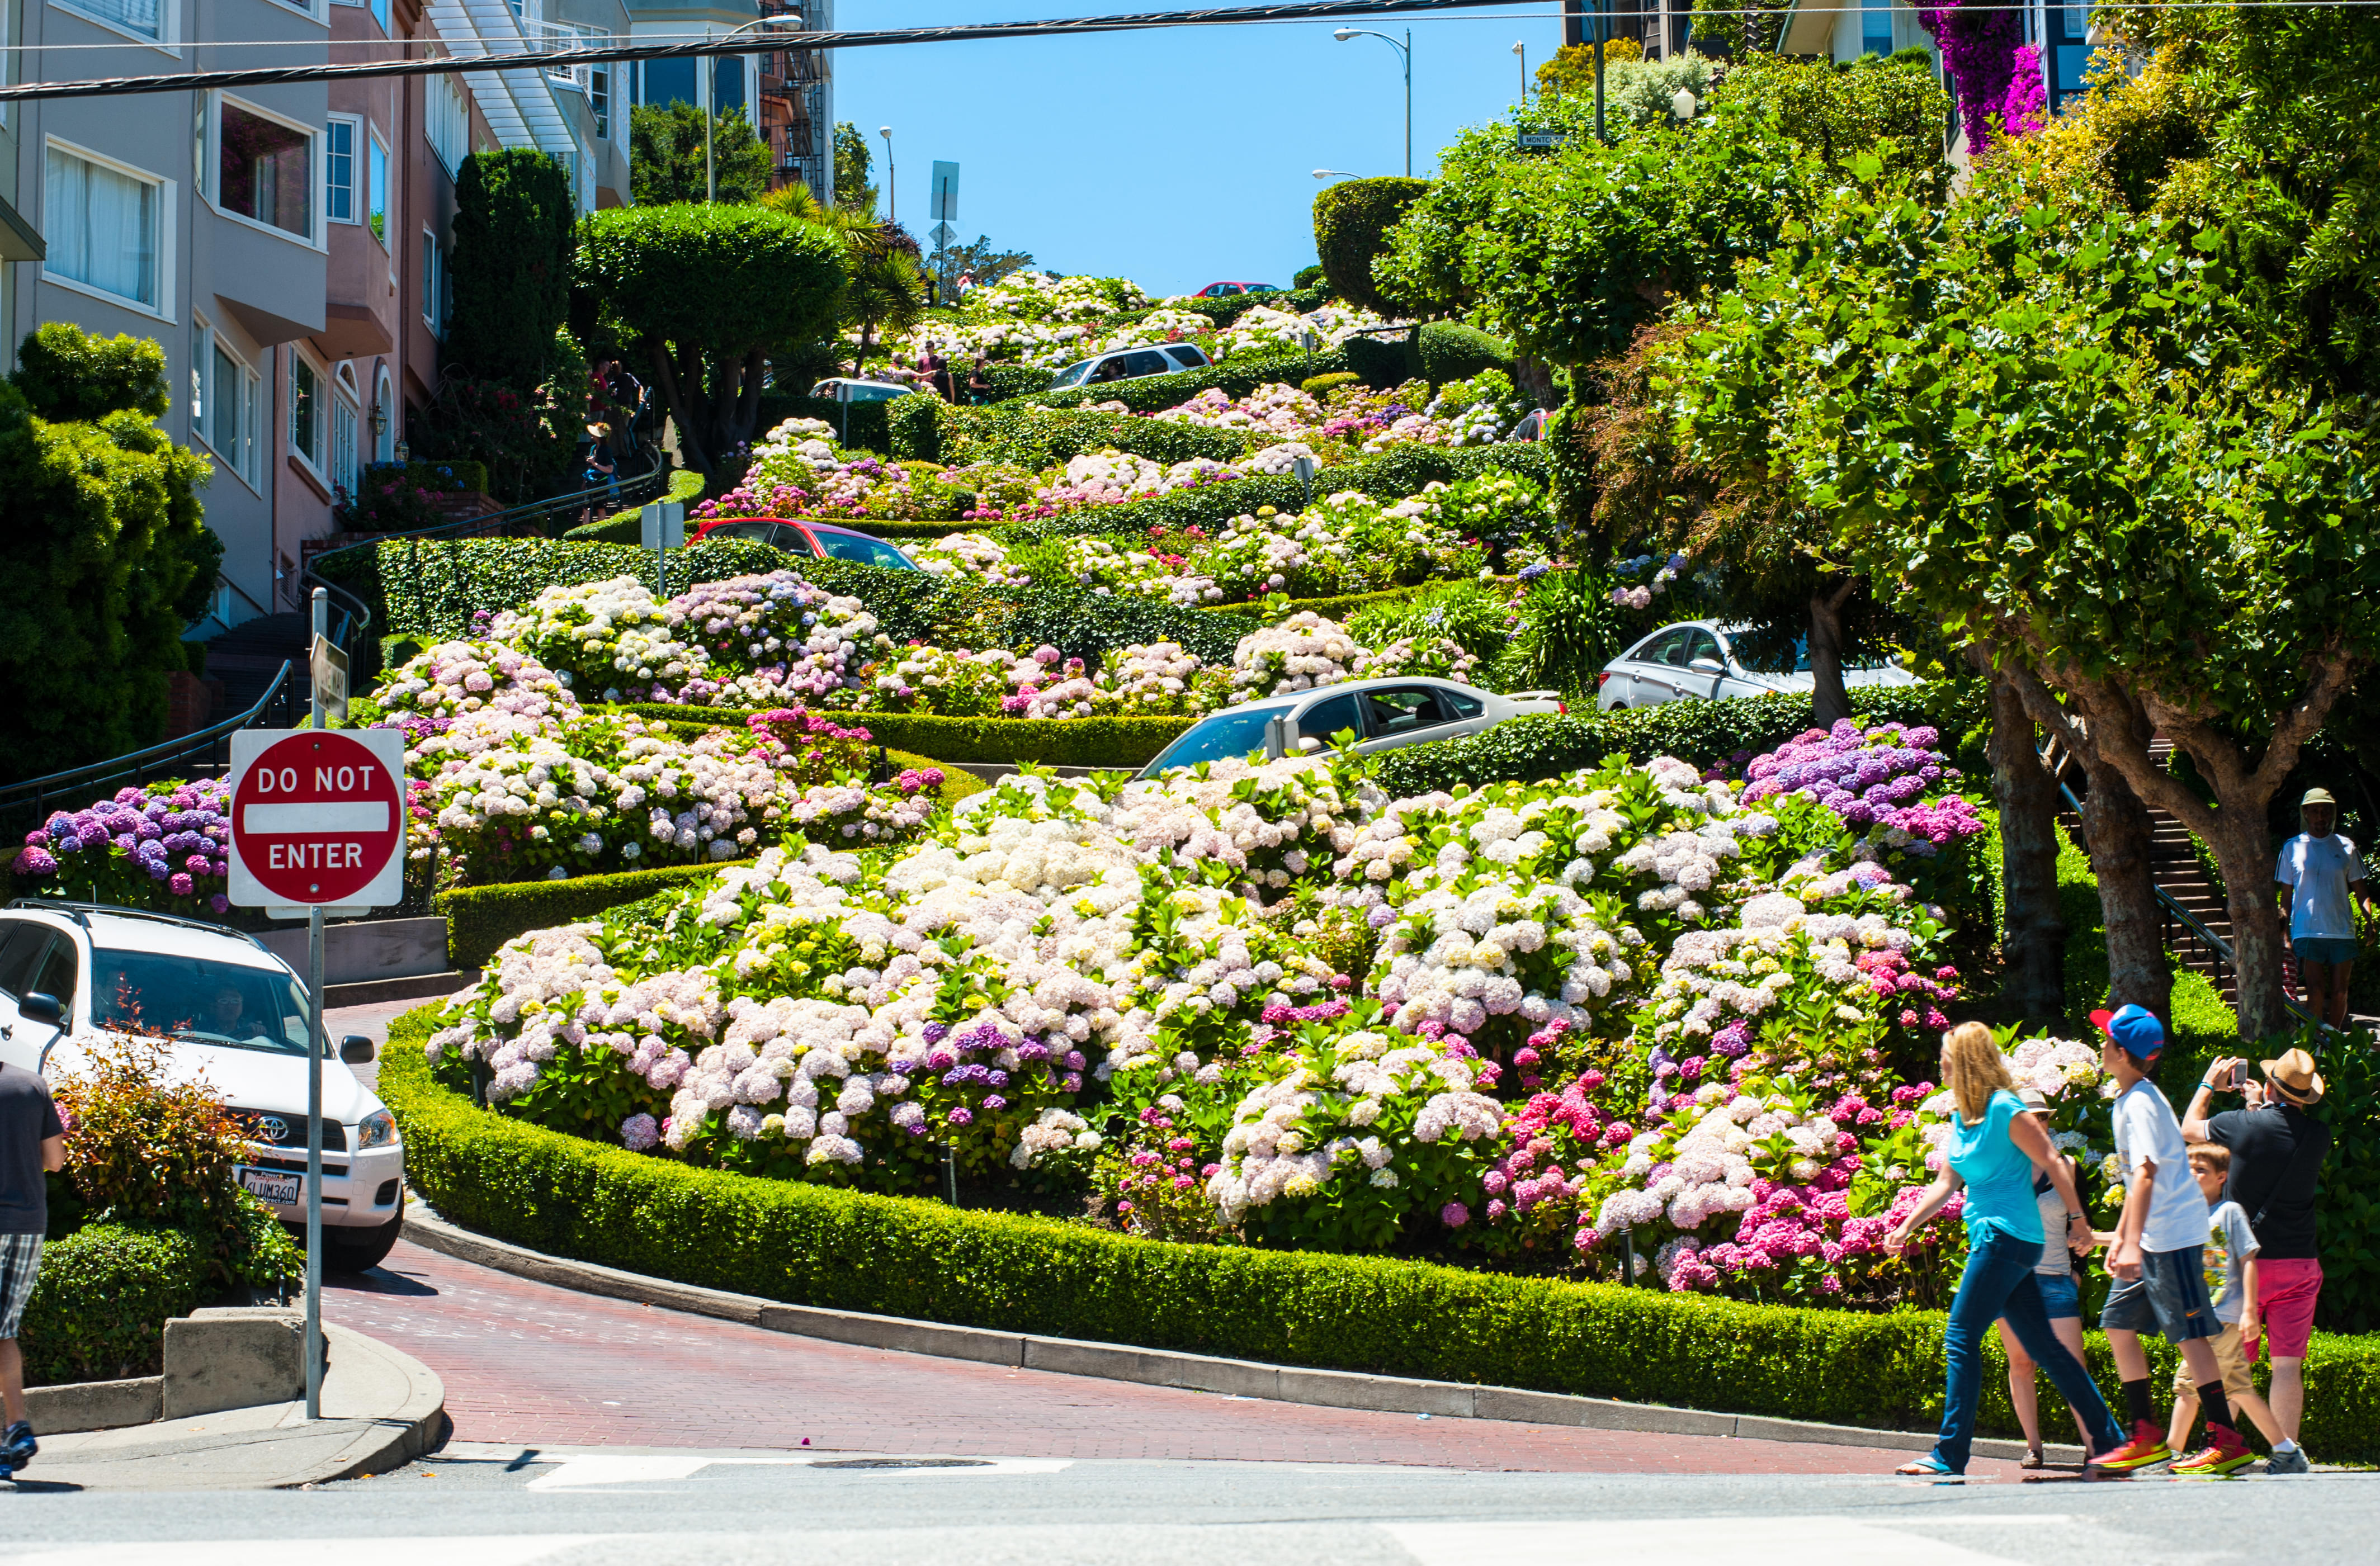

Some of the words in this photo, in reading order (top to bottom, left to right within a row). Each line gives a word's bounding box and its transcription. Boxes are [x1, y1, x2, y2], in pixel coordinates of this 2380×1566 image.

[333, 668, 344, 697] WAY
[258, 768, 298, 793] DO
[315, 766, 375, 792] NOT
[270, 843, 362, 869] ENTER
[245, 1182, 294, 1199] 6LUM360
